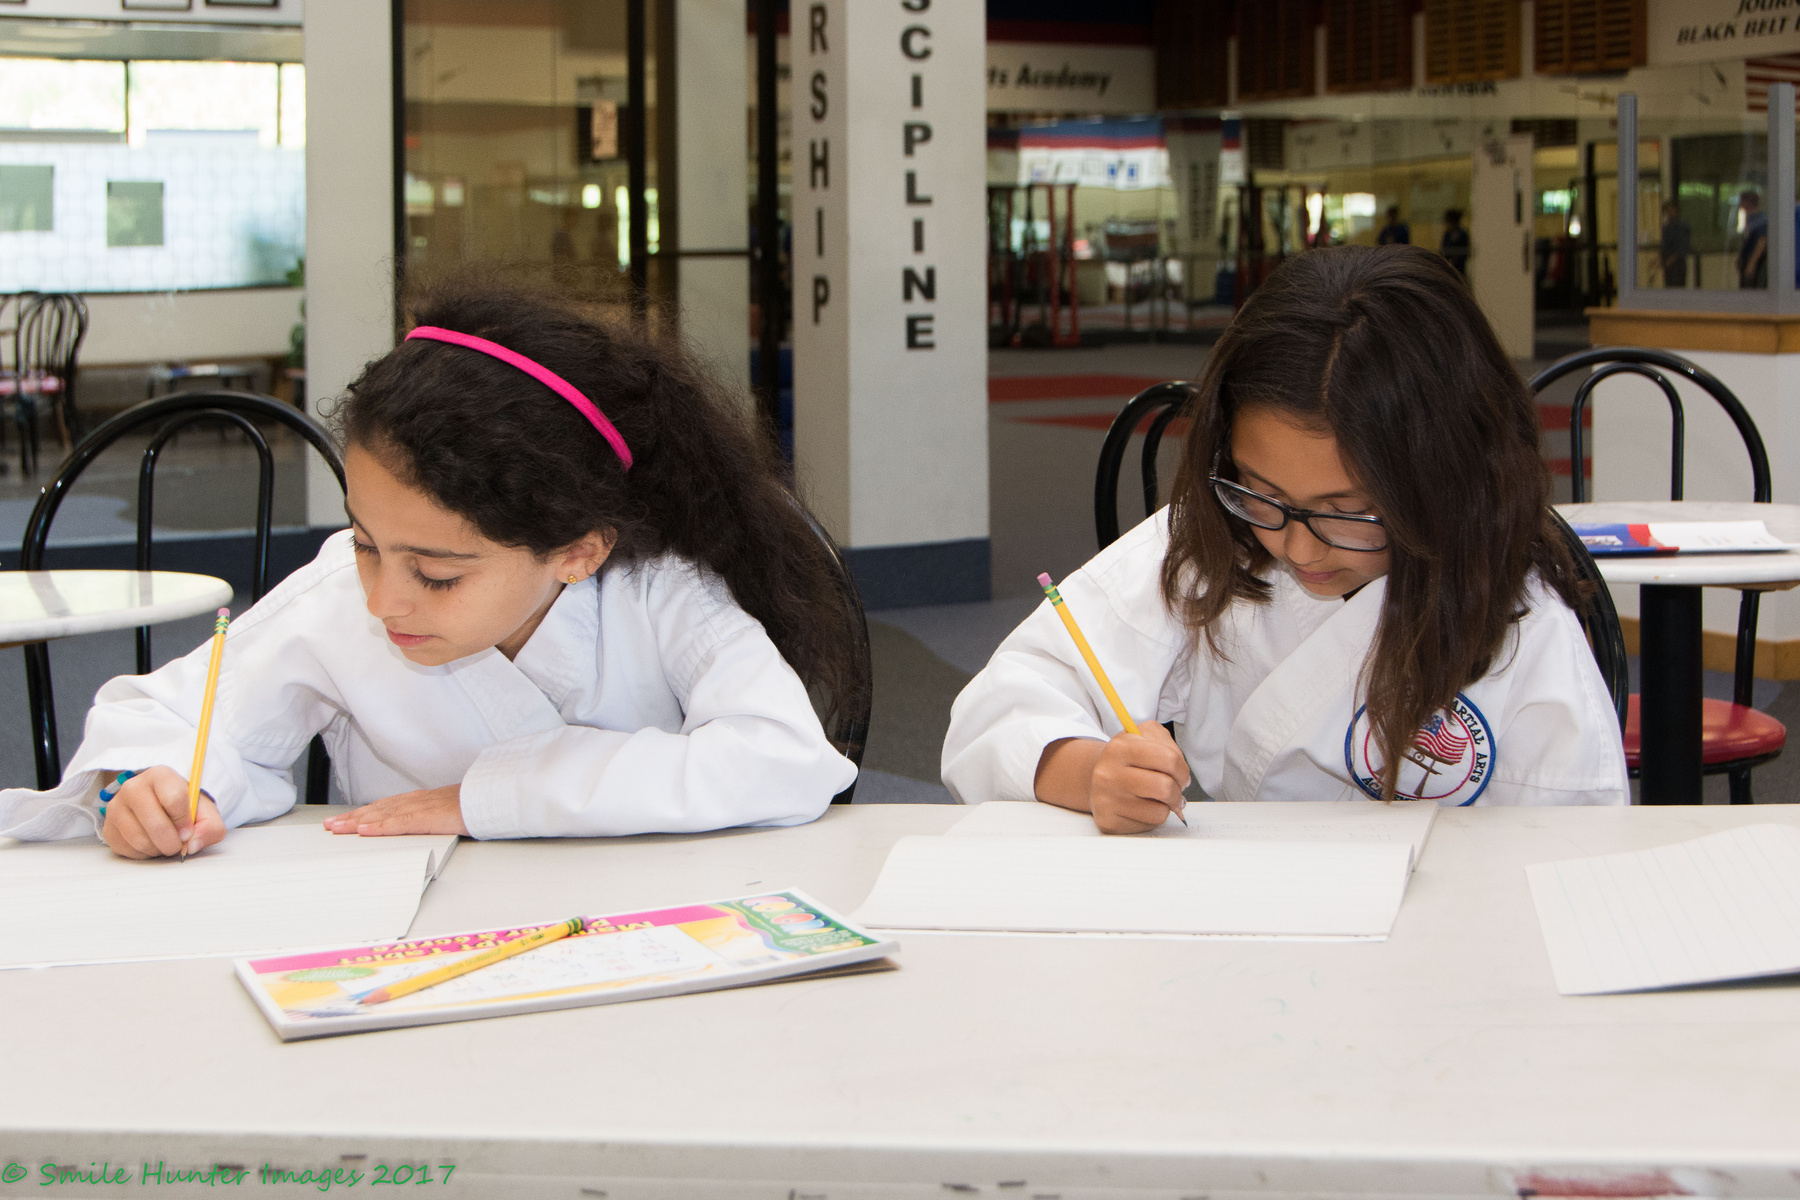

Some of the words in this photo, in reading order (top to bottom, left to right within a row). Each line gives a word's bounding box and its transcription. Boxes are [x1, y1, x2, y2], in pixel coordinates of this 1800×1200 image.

[1676, 22, 1736, 45] BLACK
[1743, 16, 1787, 37] BELT
[1016, 63, 1112, 96] Academy
[809, 3, 831, 325] RSHIP
[1451, 698, 1485, 745] ARTIAL
[1468, 752, 1488, 784] ARTS
